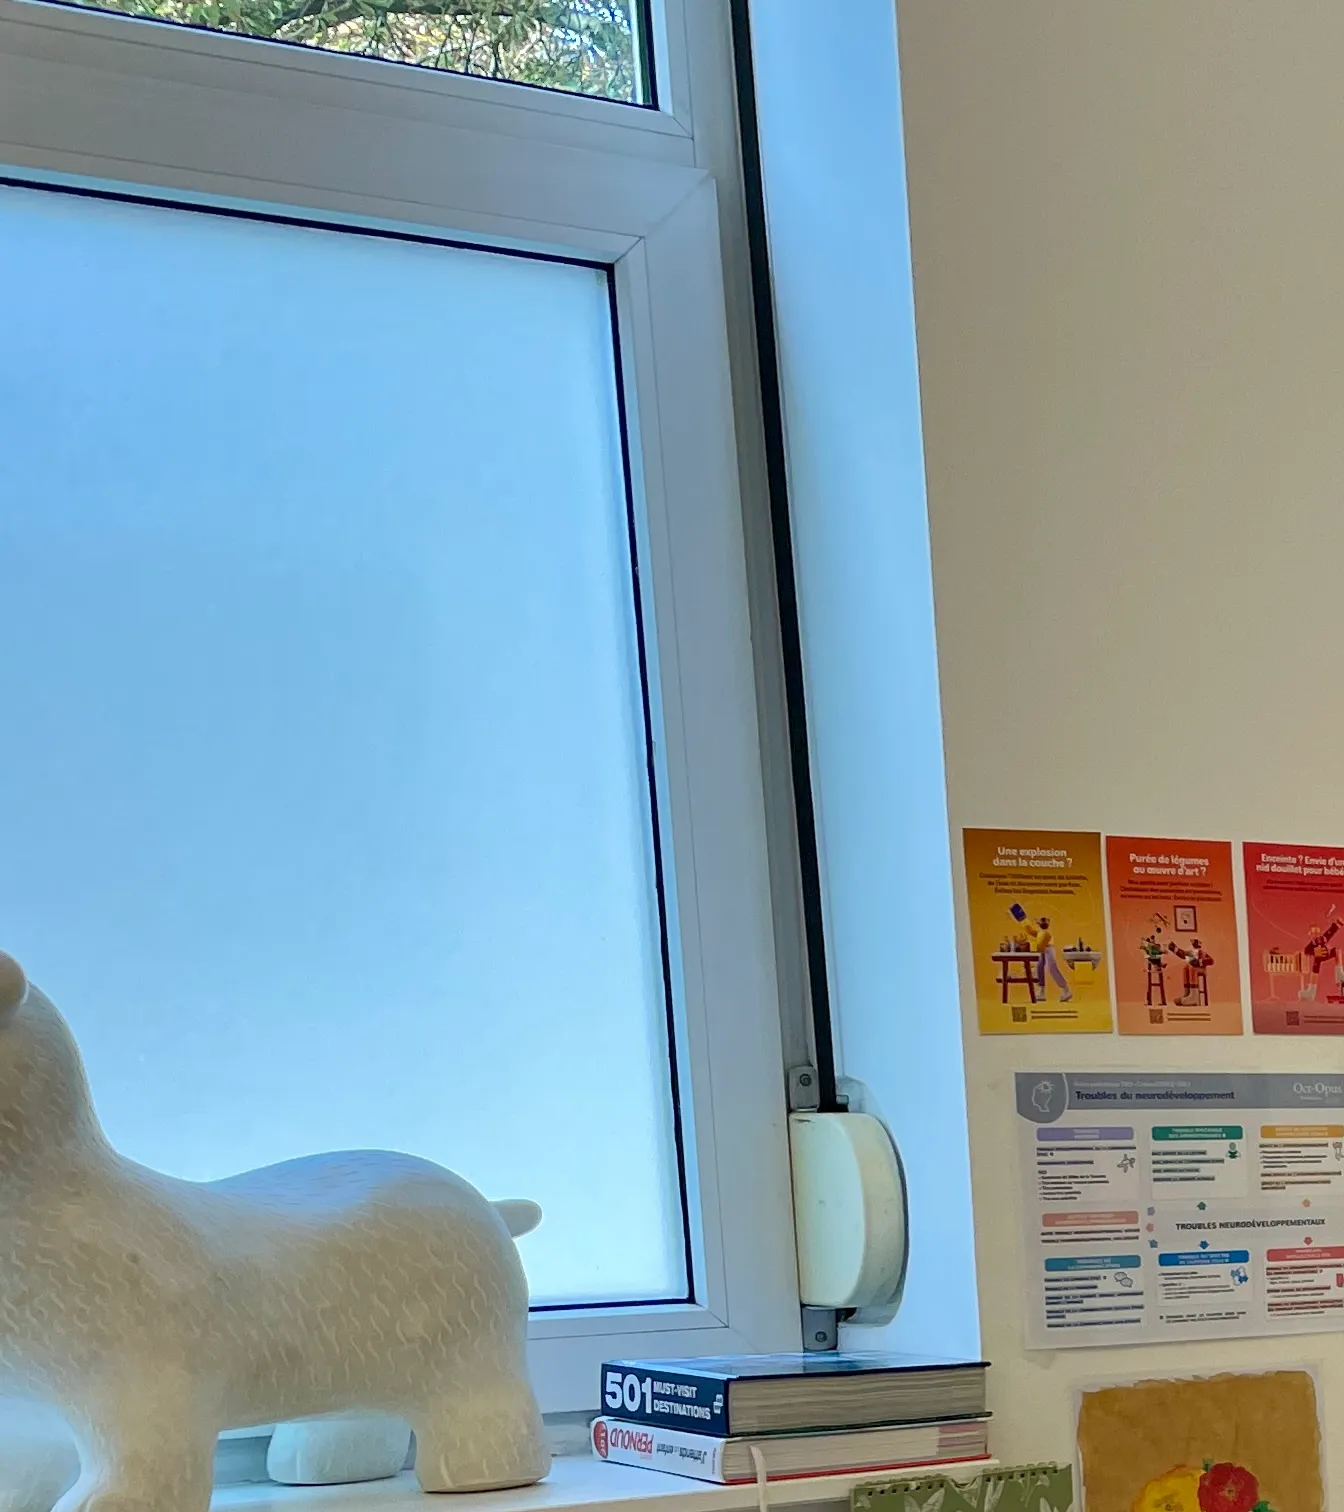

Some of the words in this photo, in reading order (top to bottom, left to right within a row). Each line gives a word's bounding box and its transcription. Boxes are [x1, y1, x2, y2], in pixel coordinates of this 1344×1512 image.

[998, 846, 1017, 856] Une
[1019, 847, 1067, 859] explosion
[993, 857, 1017, 867] dans
[1018, 857, 1028, 867] la
[1029, 859, 1065, 868] couche
[1129, 853, 1157, 863] Purée
[1158, 854, 1169, 864] de
[1171, 855, 1209, 868] légumes
[1261, 853, 1296, 864] Enceinte
[1305, 856, 1326, 865] Envie
[1328, 857, 1344, 866] d'un
[1133, 866, 1145, 874] ou
[1178, 866, 1199, 876] d'art
[1271, 864, 1302, 874] douillet
[1303, 866, 1323, 876] pour
[1324, 866, 1344, 876] bébé
[1075, 1090, 1118, 1101] Troubles
[1120, 1090, 1133, 1100] du
[1135, 1090, 1236, 1101] neurodéveloppement
[1175, 1221, 1218, 1231] TROUBLES
[1218, 1218, 1326, 1230] NEURODÉVELOPPEMENTAUX
[605, 1371, 652, 1414] 501
[653, 1381, 697, 1398] MUST-VISIT
[654, 1400, 711, 1420] DESTINATIONS
[610, 1428, 654, 1454] PERNOUD
